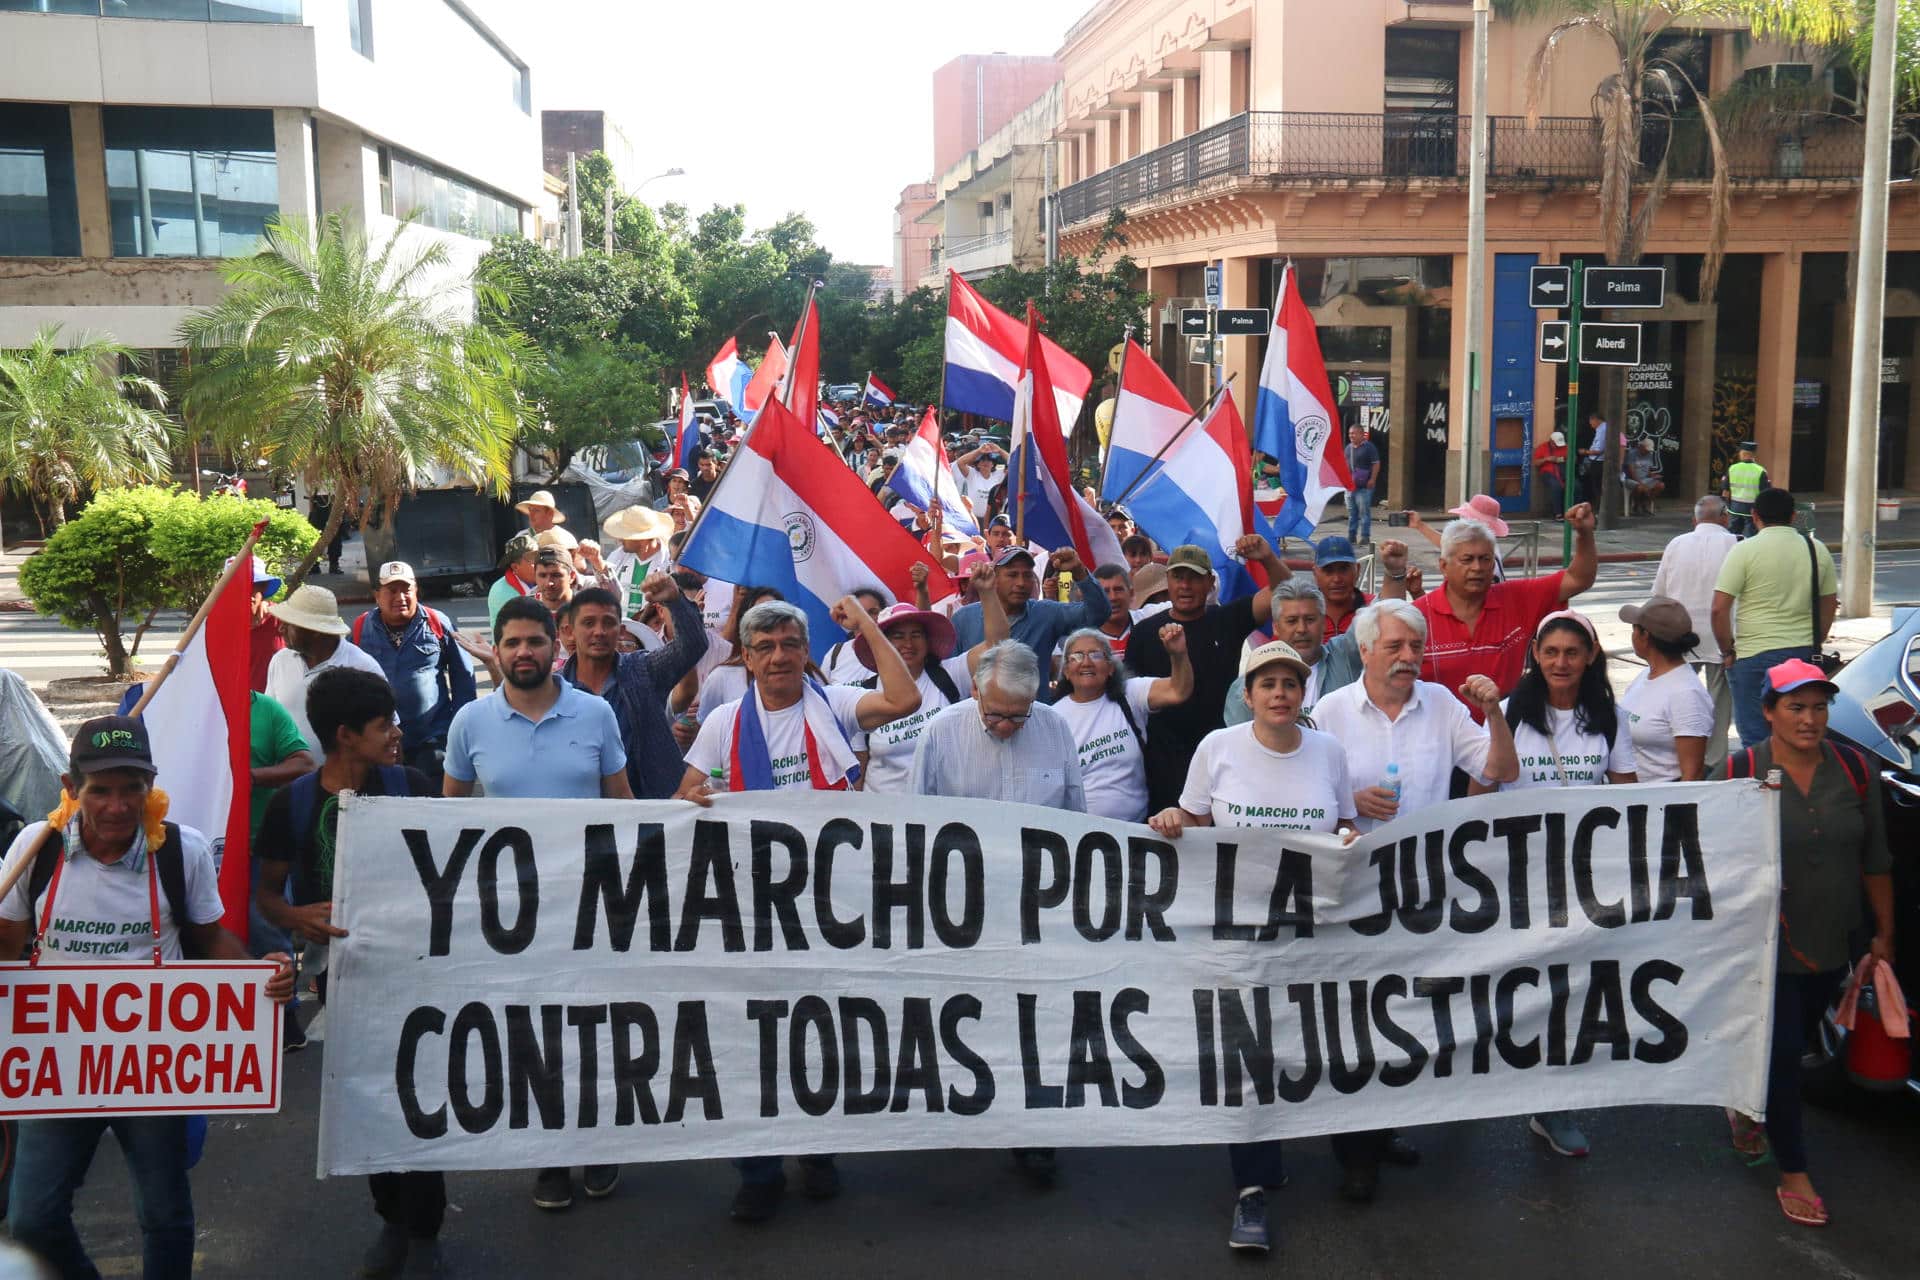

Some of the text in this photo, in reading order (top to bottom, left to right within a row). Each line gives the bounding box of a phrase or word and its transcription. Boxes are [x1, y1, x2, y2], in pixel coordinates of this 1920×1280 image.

[1607, 281, 1641, 293] Palma
[1231, 317, 1254, 325] Palma
[1595, 337, 1626, 350] Alberdi
[1627, 380, 1673, 390] AGRADABLE
[1629, 372, 1668, 381] SORPRESA
[1257, 647, 1299, 658] JUSTICIA
[892, 714, 924, 731] MARCHO
[111, 730, 133, 740] pro
[888, 734, 901, 745] LA
[1078, 729, 1129, 755] MARCHO POR
[1089, 744, 1126, 764] JUSTICIA
[1521, 754, 1602, 767] YO MACHO POR
[771, 769, 812, 786] USTICIA
[1532, 771, 1547, 782] LA
[1228, 802, 1325, 819] YO MARCHO POR
[402, 804, 1714, 956] YO MARCHO POR LA JUSTICIA
[54, 918, 152, 935] MARCHO POR
[47, 935, 129, 955] LA JUSTICIA
[0, 983, 257, 1034] ENCION
[396, 959, 1689, 1140] CONTRA TODAS LAS INJUSTICIAS
[78, 1044, 263, 1095] MARCHA
